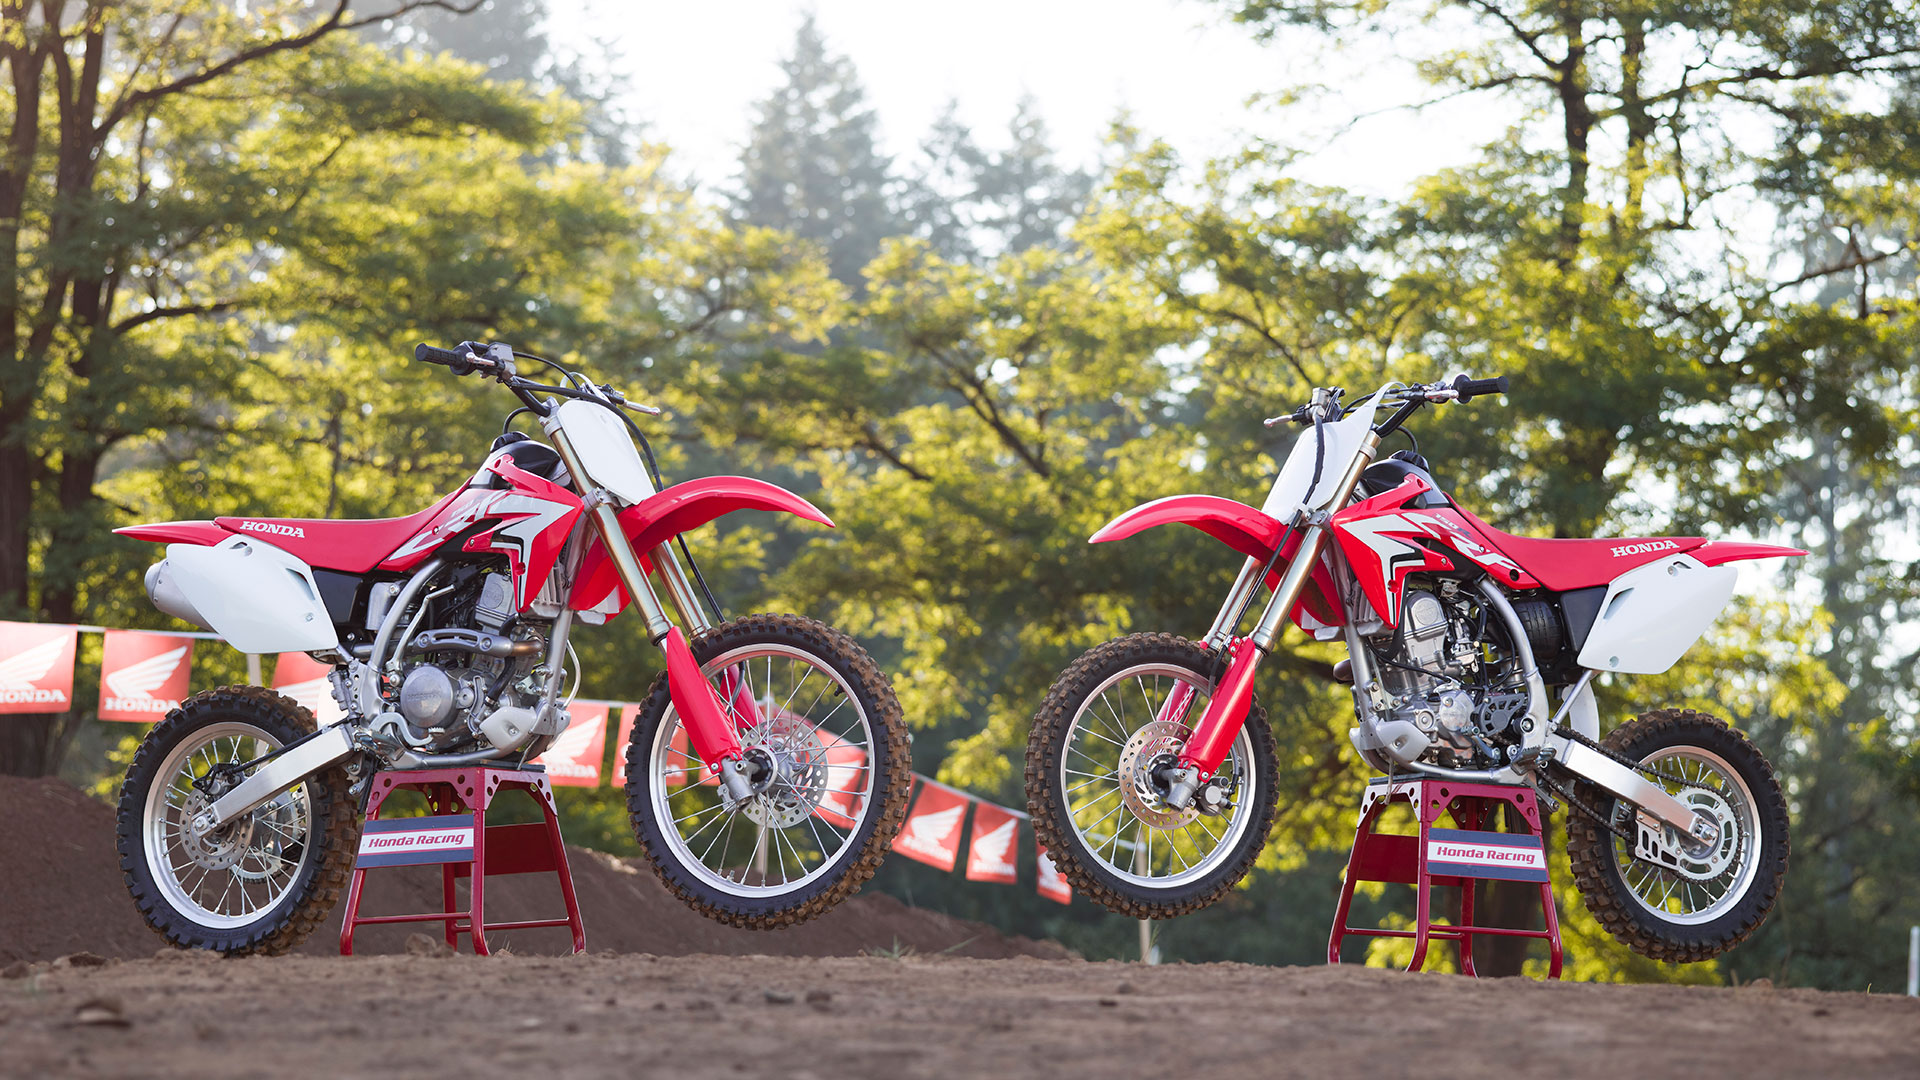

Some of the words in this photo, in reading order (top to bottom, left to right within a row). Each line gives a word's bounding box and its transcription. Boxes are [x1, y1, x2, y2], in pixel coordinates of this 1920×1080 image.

[240, 521, 305, 538] HONDA
[1435, 513, 1471, 538] 150R
[1610, 540, 1680, 557] HONDA
[0, 689, 67, 704] ONDA
[368, 836, 414, 848] Honda
[416, 834, 465, 845] Racing
[1437, 846, 1484, 859] Honda
[1486, 850, 1535, 865] Racing
